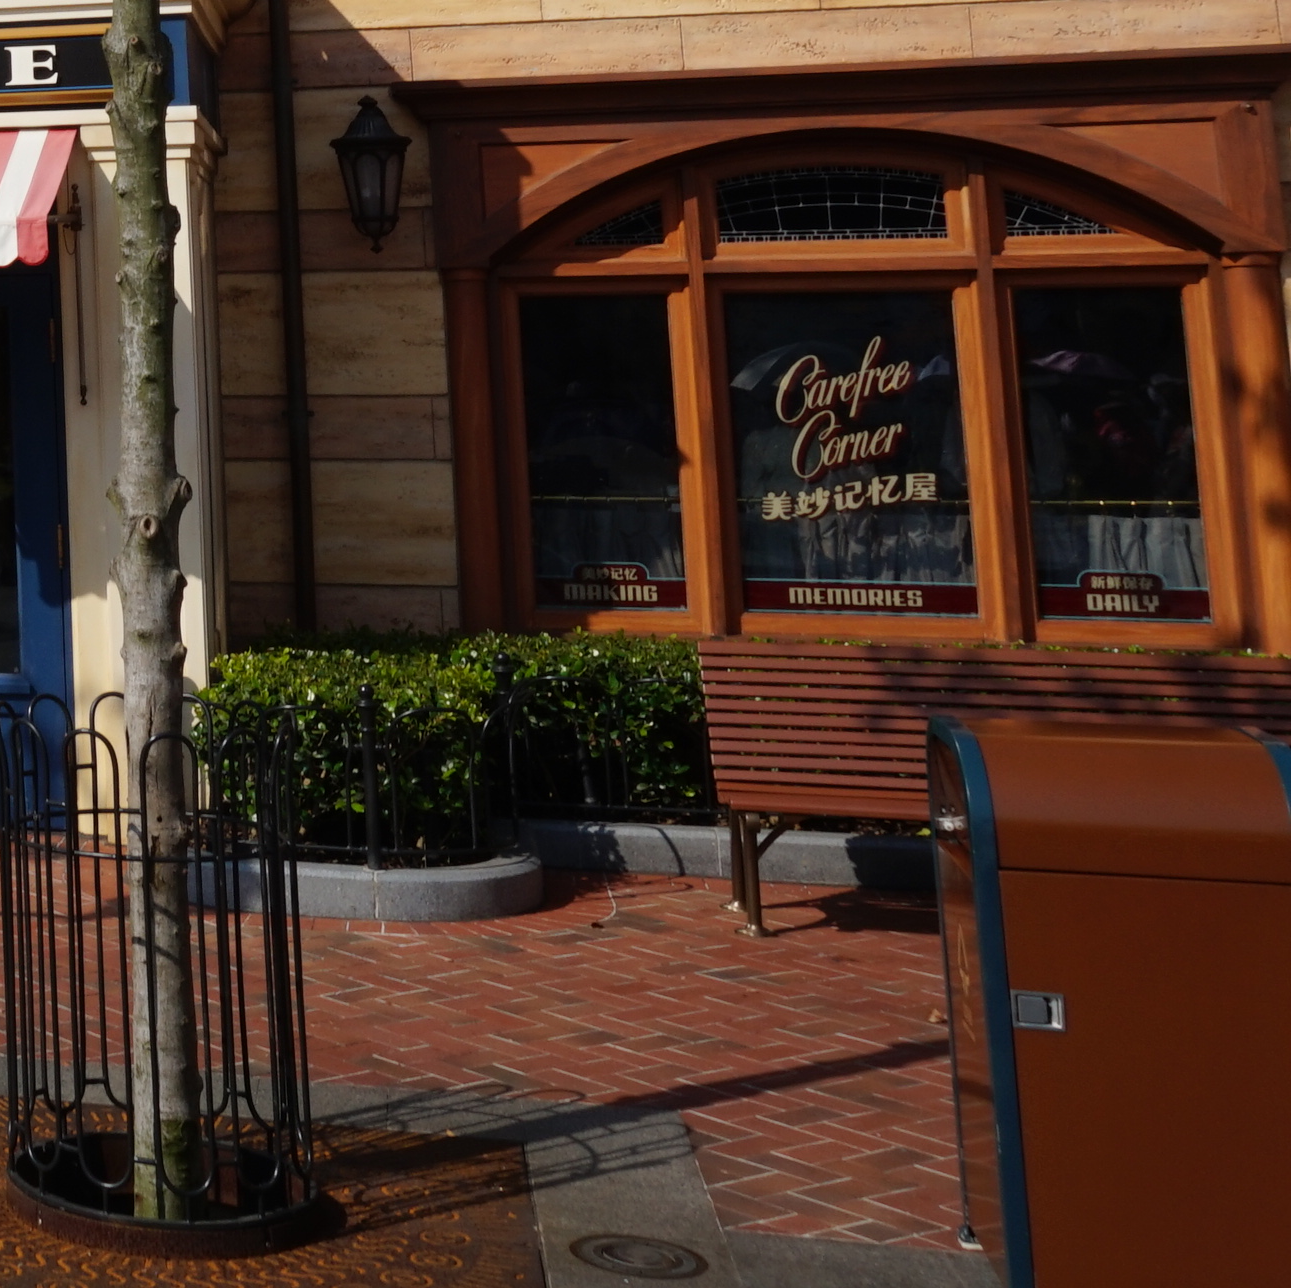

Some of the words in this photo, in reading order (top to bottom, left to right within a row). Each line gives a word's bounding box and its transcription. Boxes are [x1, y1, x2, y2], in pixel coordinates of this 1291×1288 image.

[775, 335, 911, 423] Carefree
[791, 409, 903, 479] Corner
[761, 472, 939, 521] 美妙记忆屋
[563, 583, 658, 602] MAKING
[788, 586, 923, 608] MEMORIES
[1086, 593, 1160, 613] DAILY
